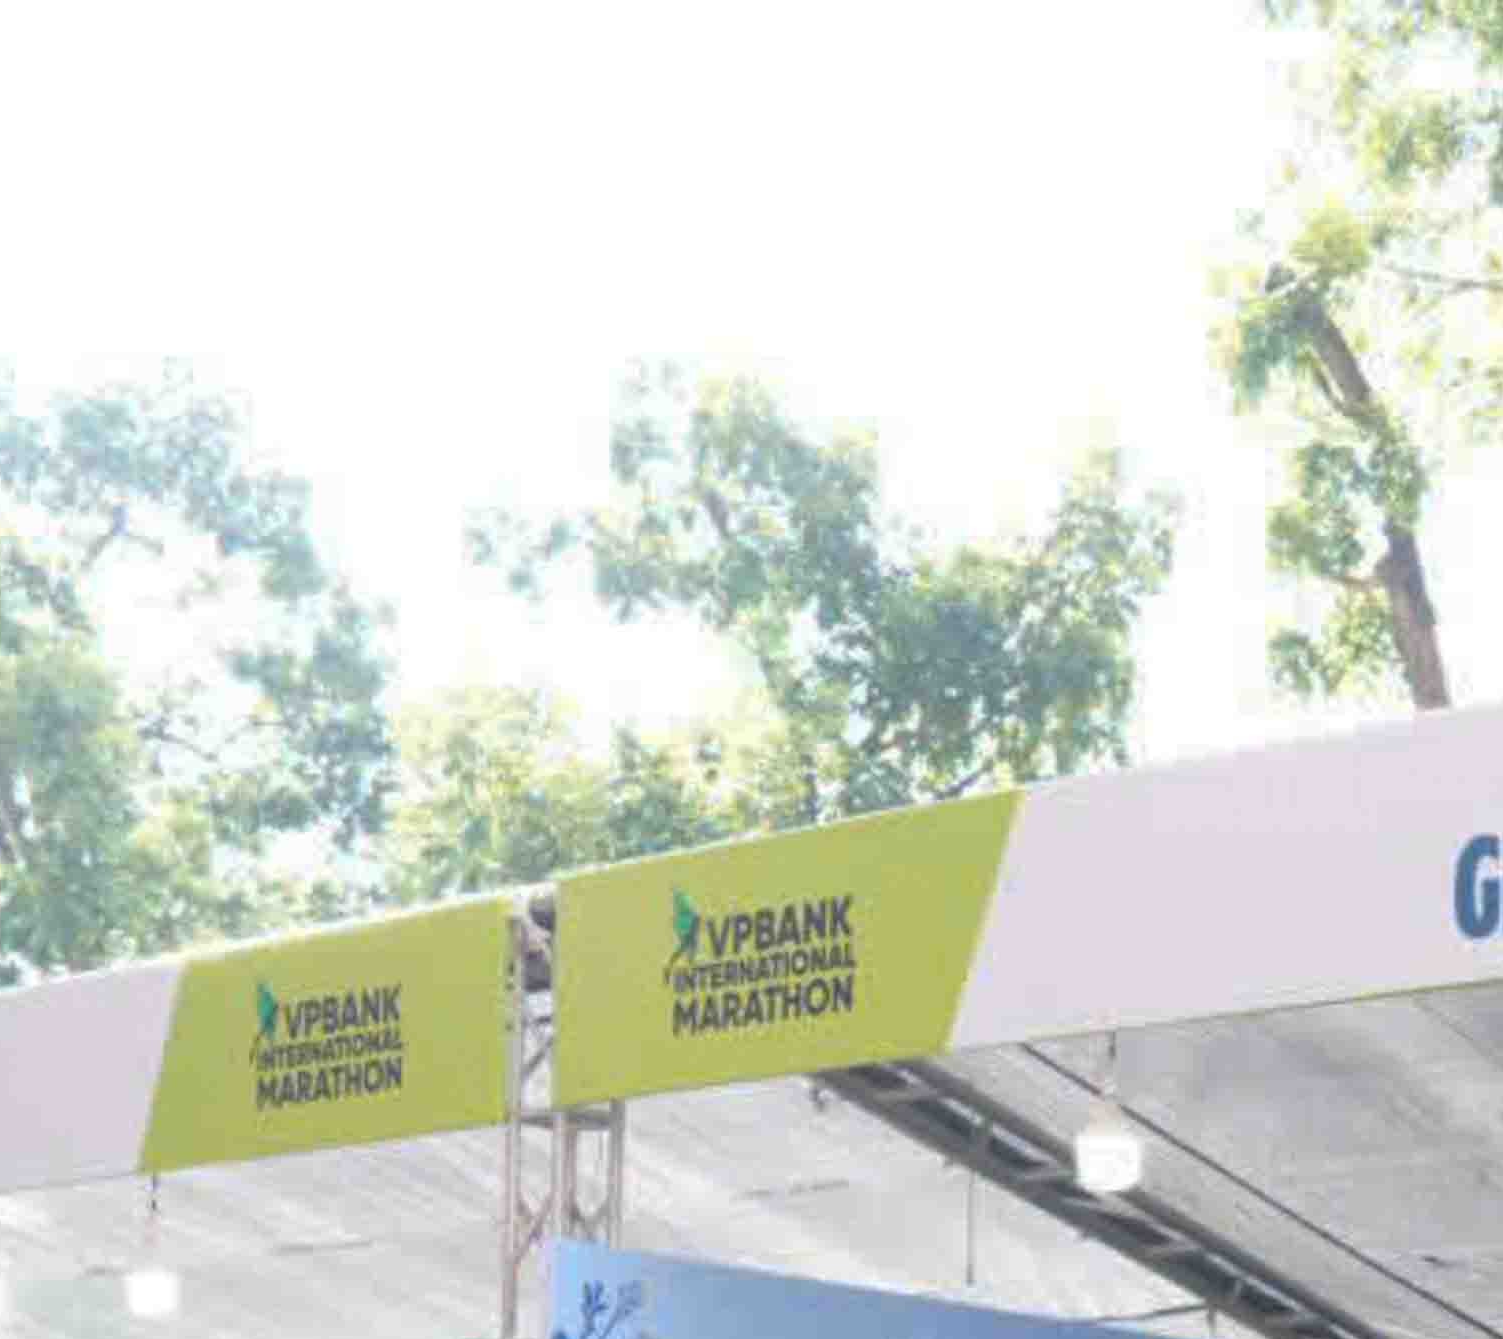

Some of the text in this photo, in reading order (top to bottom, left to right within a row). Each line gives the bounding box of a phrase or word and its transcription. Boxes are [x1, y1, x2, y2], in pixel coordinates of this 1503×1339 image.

[705, 891, 854, 957] VPBANK
[673, 942, 857, 993] INTERNATIONAL
[286, 982, 402, 1039] VPBANK
[673, 974, 854, 1039] MARATHON
[257, 1055, 403, 1112] MARATHON
